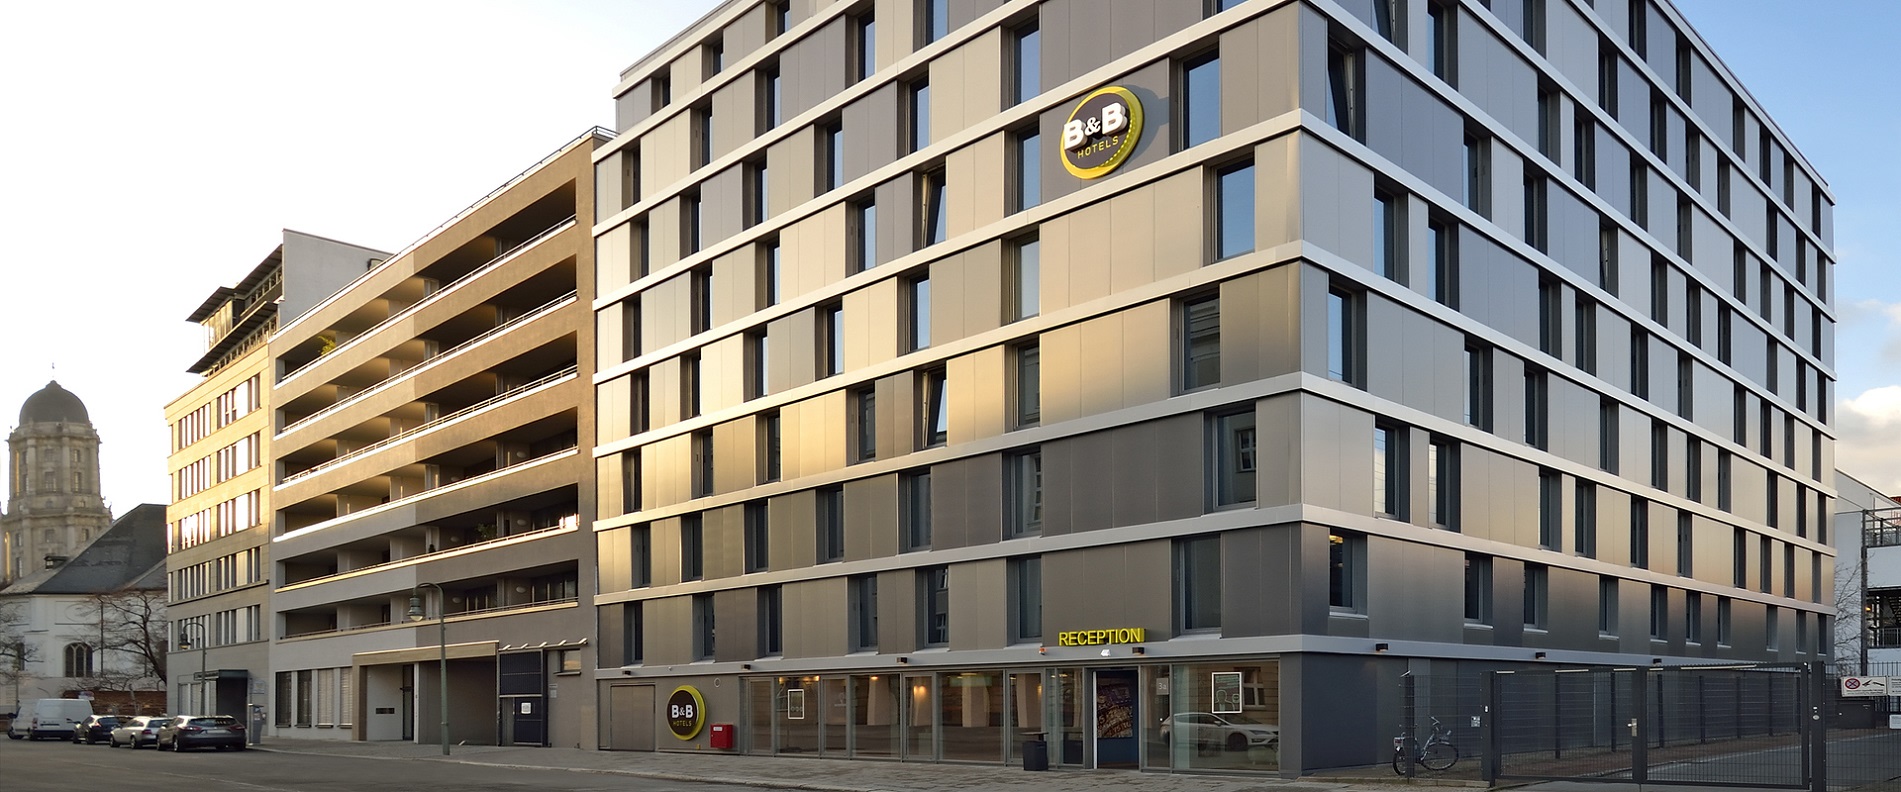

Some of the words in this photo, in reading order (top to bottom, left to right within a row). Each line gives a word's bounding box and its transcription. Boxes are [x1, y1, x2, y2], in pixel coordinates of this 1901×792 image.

[1064, 102, 1127, 150] B&B
[1077, 135, 1119, 159] HOTELS
[1058, 627, 1144, 646] RECEPTION
[1158, 682, 1167, 690] 3a
[671, 704, 693, 718] B&B
